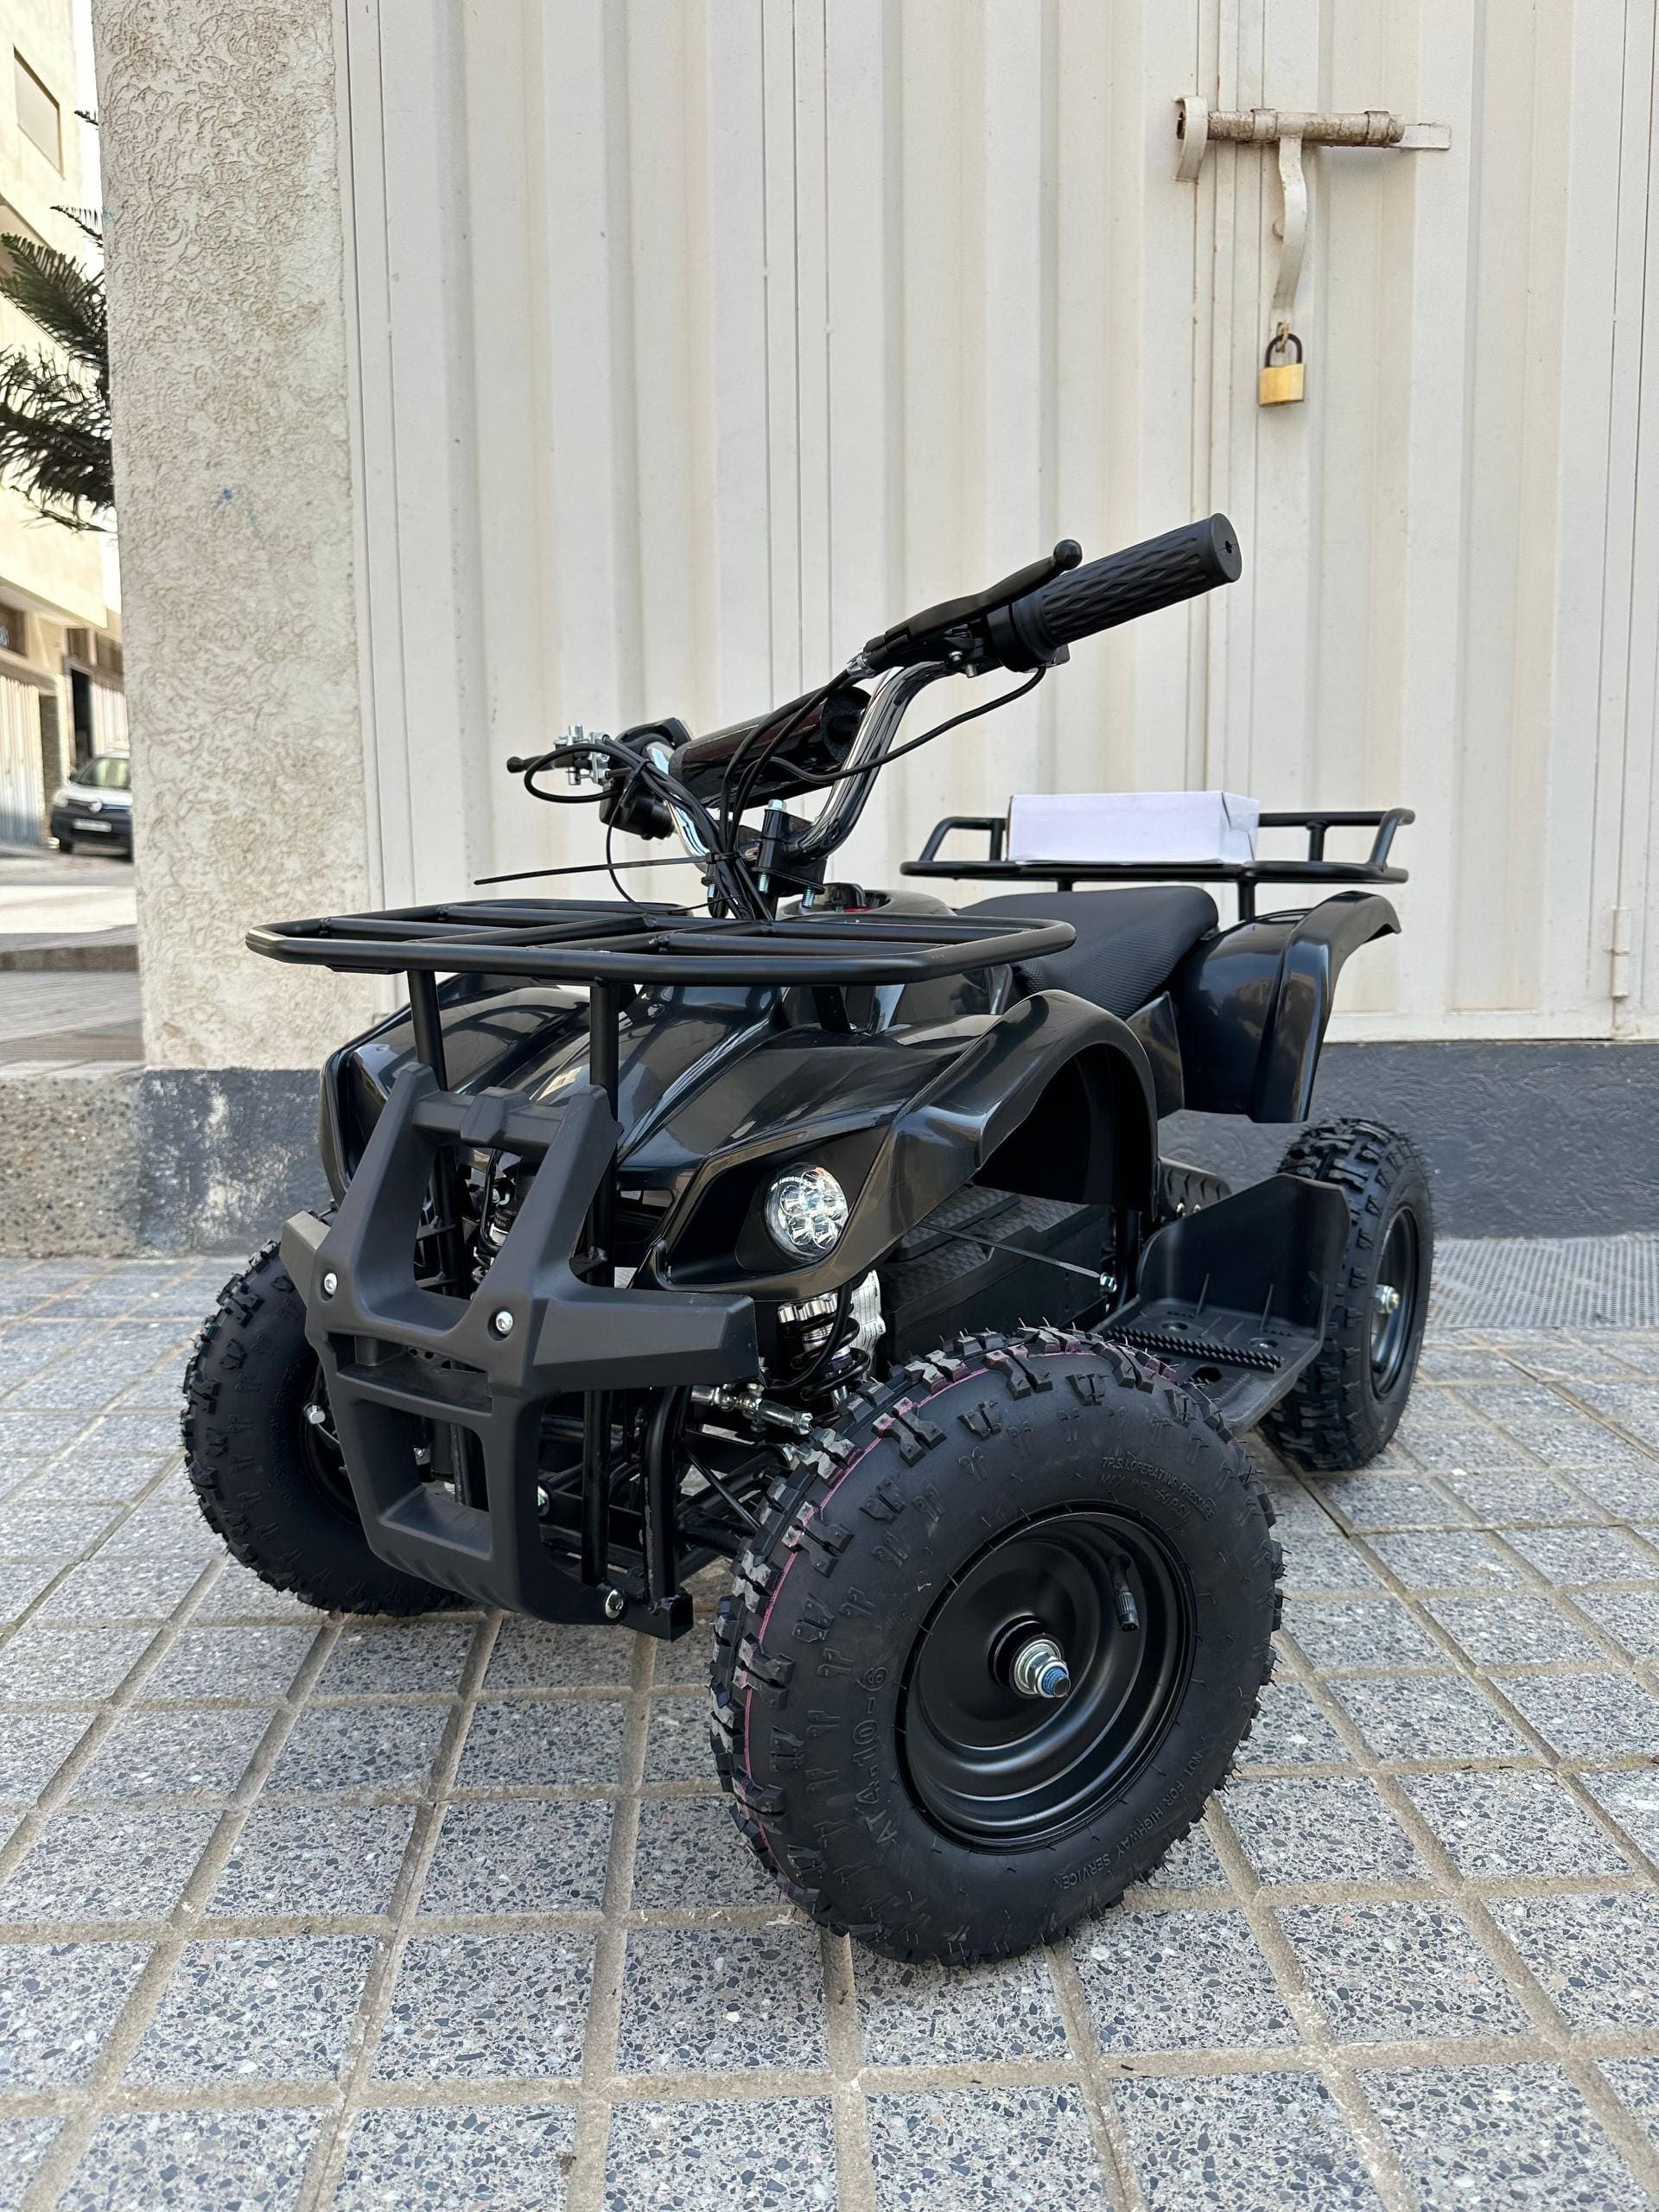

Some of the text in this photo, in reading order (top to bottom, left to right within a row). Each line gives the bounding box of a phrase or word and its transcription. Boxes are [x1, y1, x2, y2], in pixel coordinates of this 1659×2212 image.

[1184, 1751, 1204, 1777] NOT
[1162, 1780, 1185, 1806] FOR
[1116, 1807, 1163, 1857] HIGHWAY
